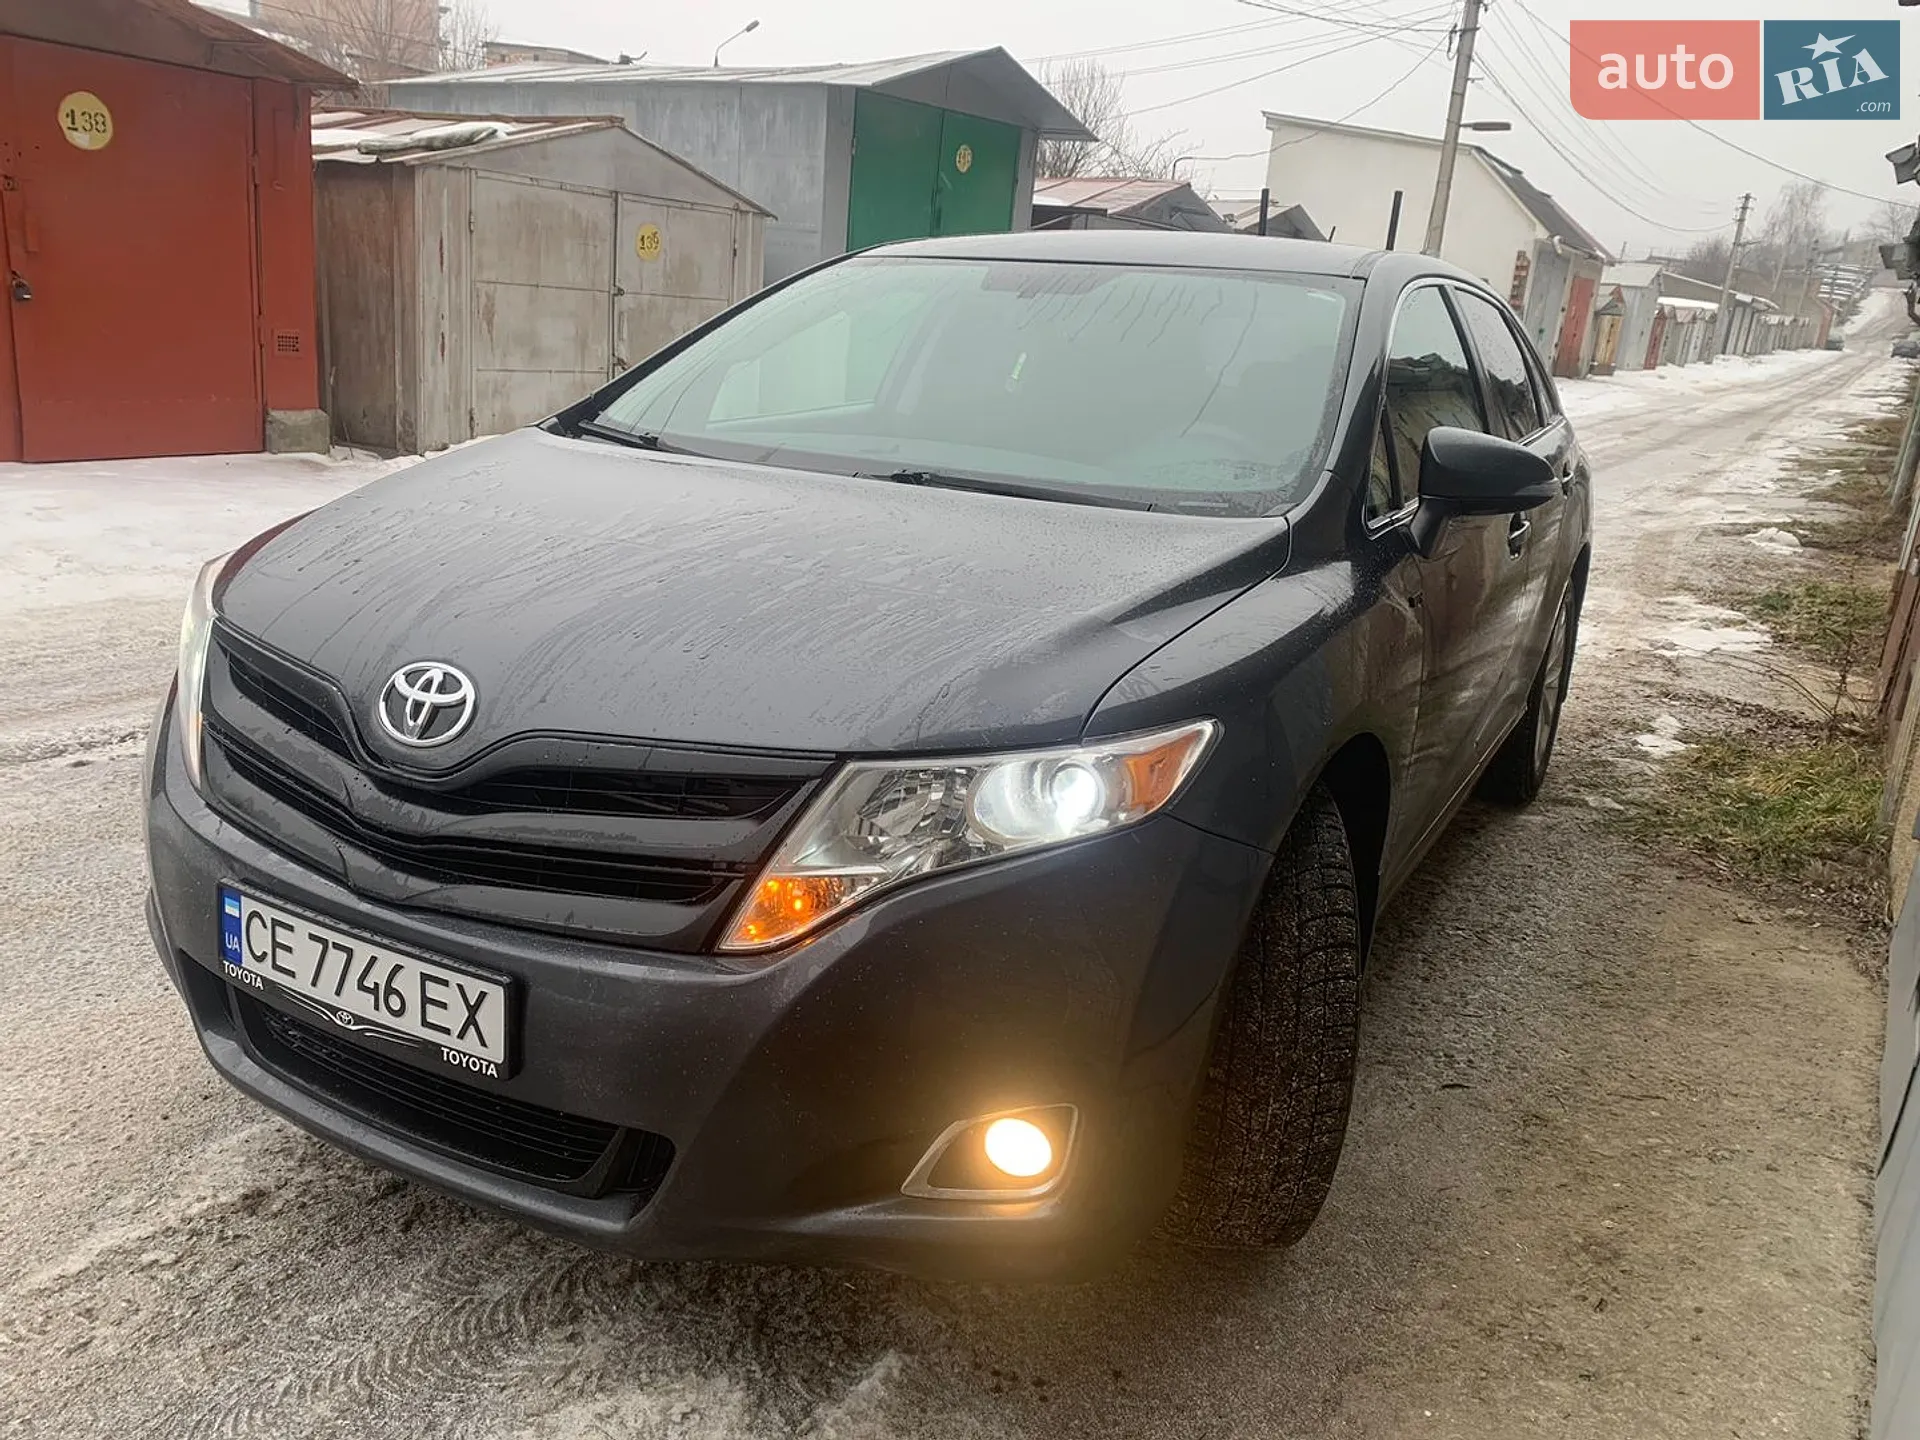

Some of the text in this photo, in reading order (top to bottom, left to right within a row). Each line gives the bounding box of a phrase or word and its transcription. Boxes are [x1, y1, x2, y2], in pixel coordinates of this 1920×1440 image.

[65, 108, 107, 133] 138
[225, 932, 240, 952] UA
[222, 960, 264, 991] TOYOTA
[245, 910, 488, 1049] CE 7746 EX
[440, 1046, 498, 1079] TOYOTA
